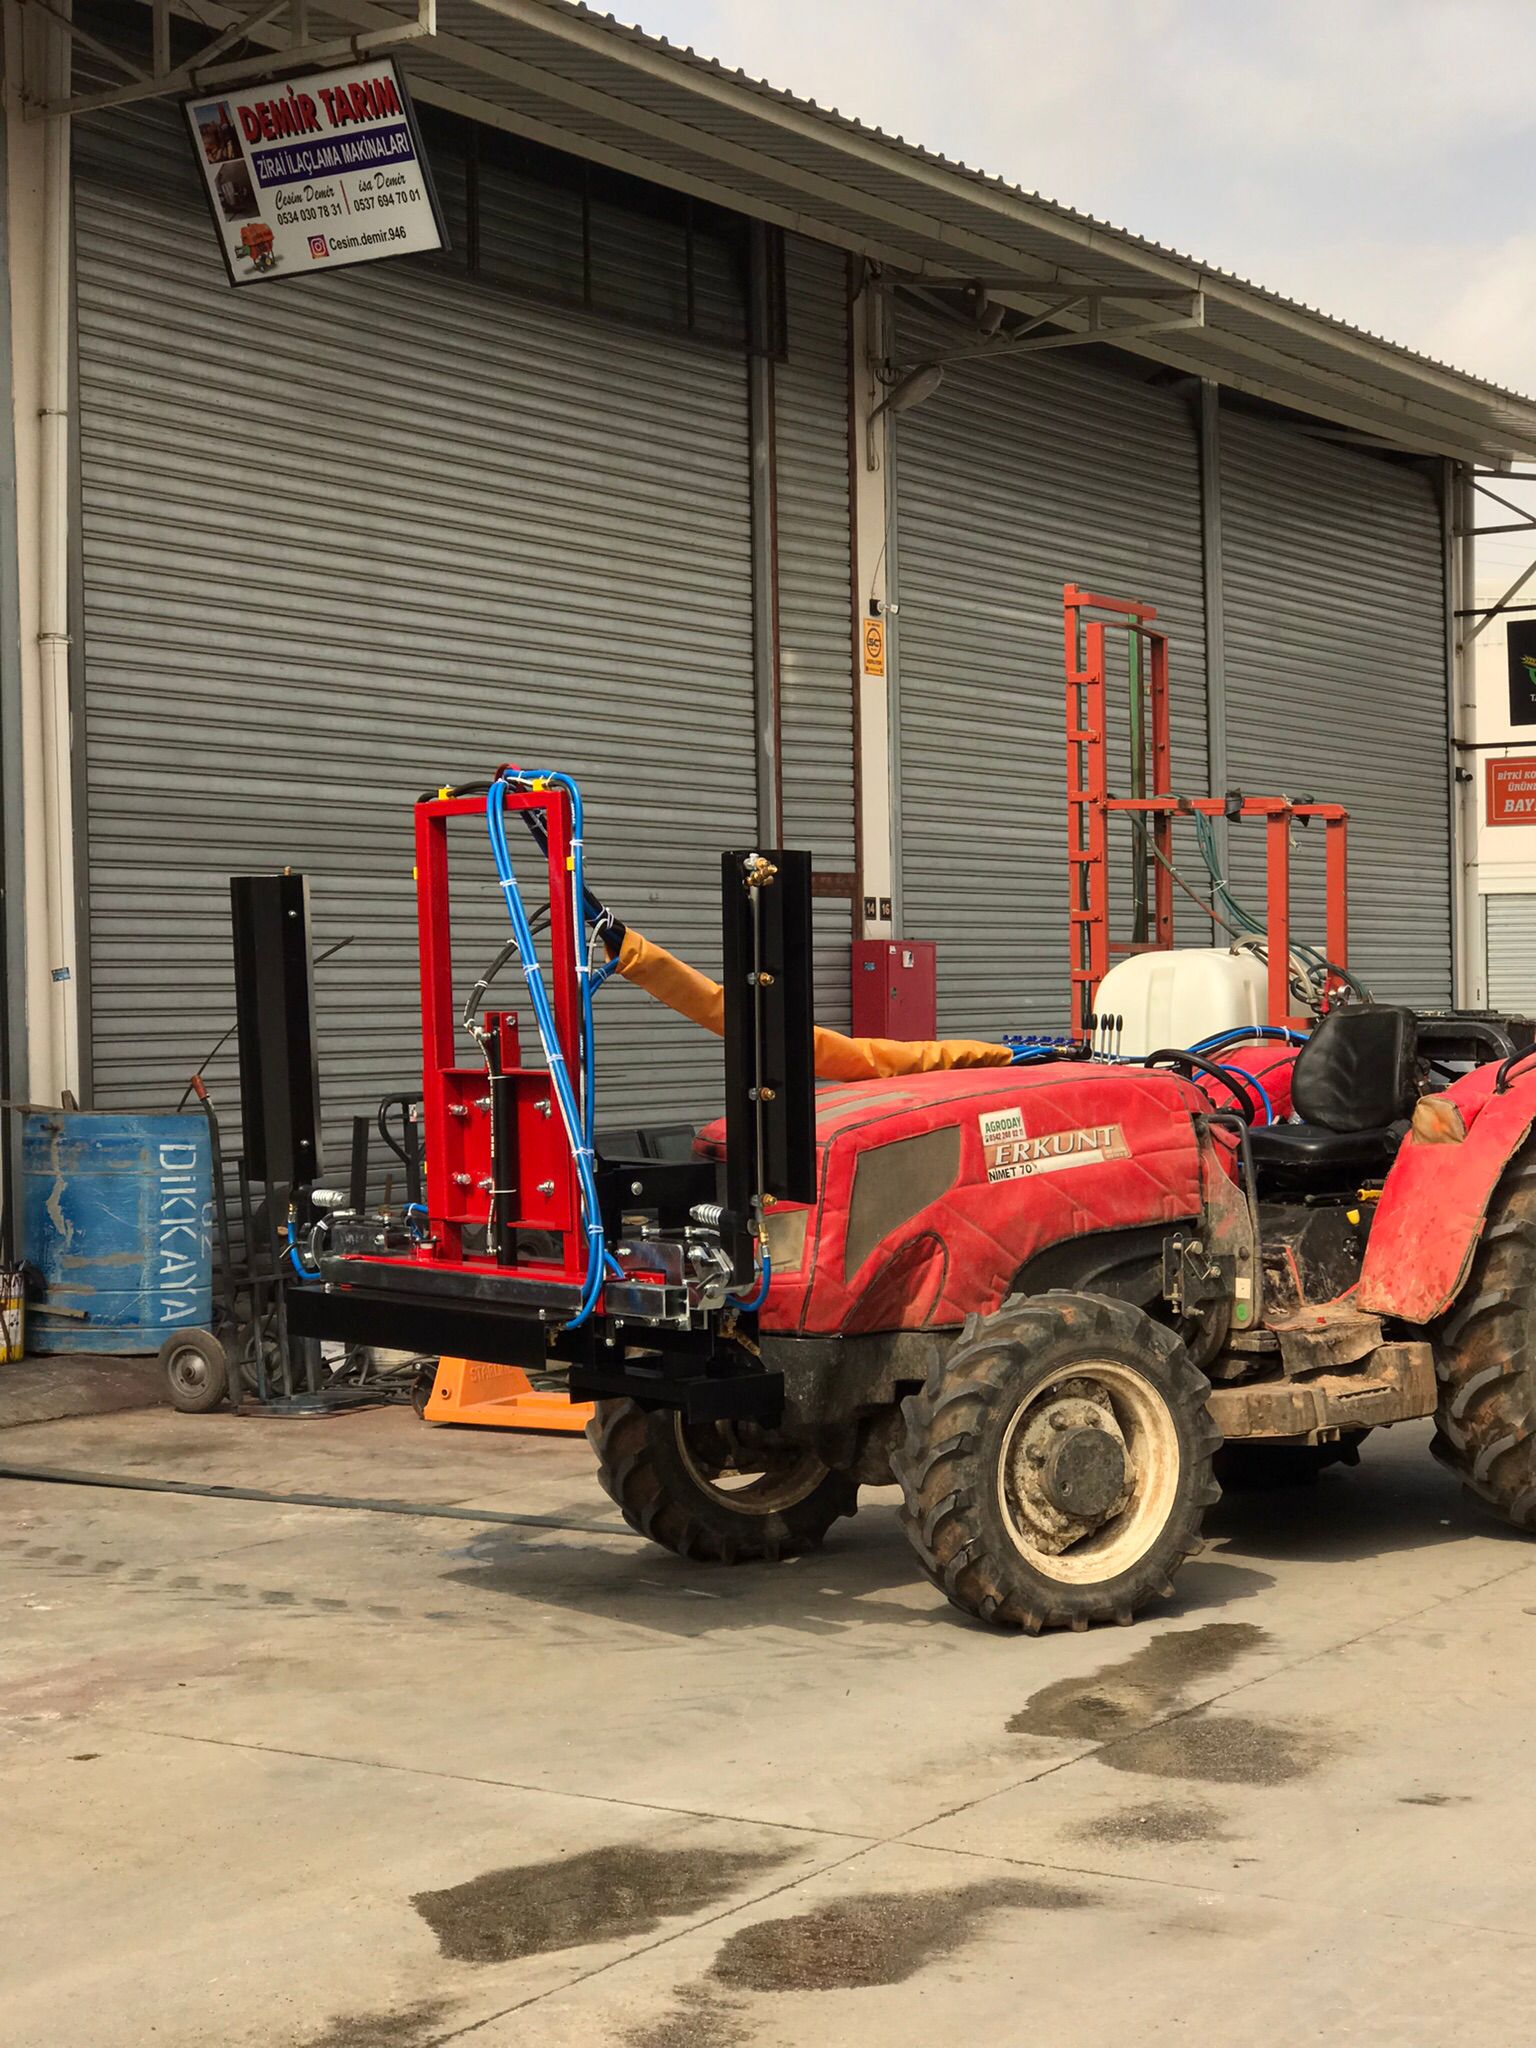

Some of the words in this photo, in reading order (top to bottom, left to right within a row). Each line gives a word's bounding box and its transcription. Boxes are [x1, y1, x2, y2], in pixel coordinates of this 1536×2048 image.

[237, 84, 322, 145] DEMİR
[317, 75, 404, 128] TARIM
[256, 152, 285, 180] ZİRAİ
[286, 146, 343, 176] İLAÇLAMA
[342, 131, 410, 165] MAKİNALARI
[374, 171, 407, 192] Demir
[275, 189, 303, 211] Cesim
[303, 184, 335, 204] Demir
[353, 196, 375, 212] 0537
[377, 193, 395, 208] 694
[396, 191, 408, 205] 70
[409, 188, 421, 202] 01
[276, 211, 299, 226] 0534
[299, 207, 317, 221] 030
[319, 204, 331, 218] 78
[331, 202, 343, 216] 31
[328, 225, 407, 251] Cesim.demir.946
[1497, 769, 1522, 781] BİTKİ
[1503, 798, 1536, 813] BAY
[866, 902, 875, 915] 14
[881, 903, 890, 915] 16
[985, 1116, 1021, 1133] AGRODAY
[994, 1127, 1116, 1166] ERKUNT
[1019, 1163, 1032, 1175] 70
